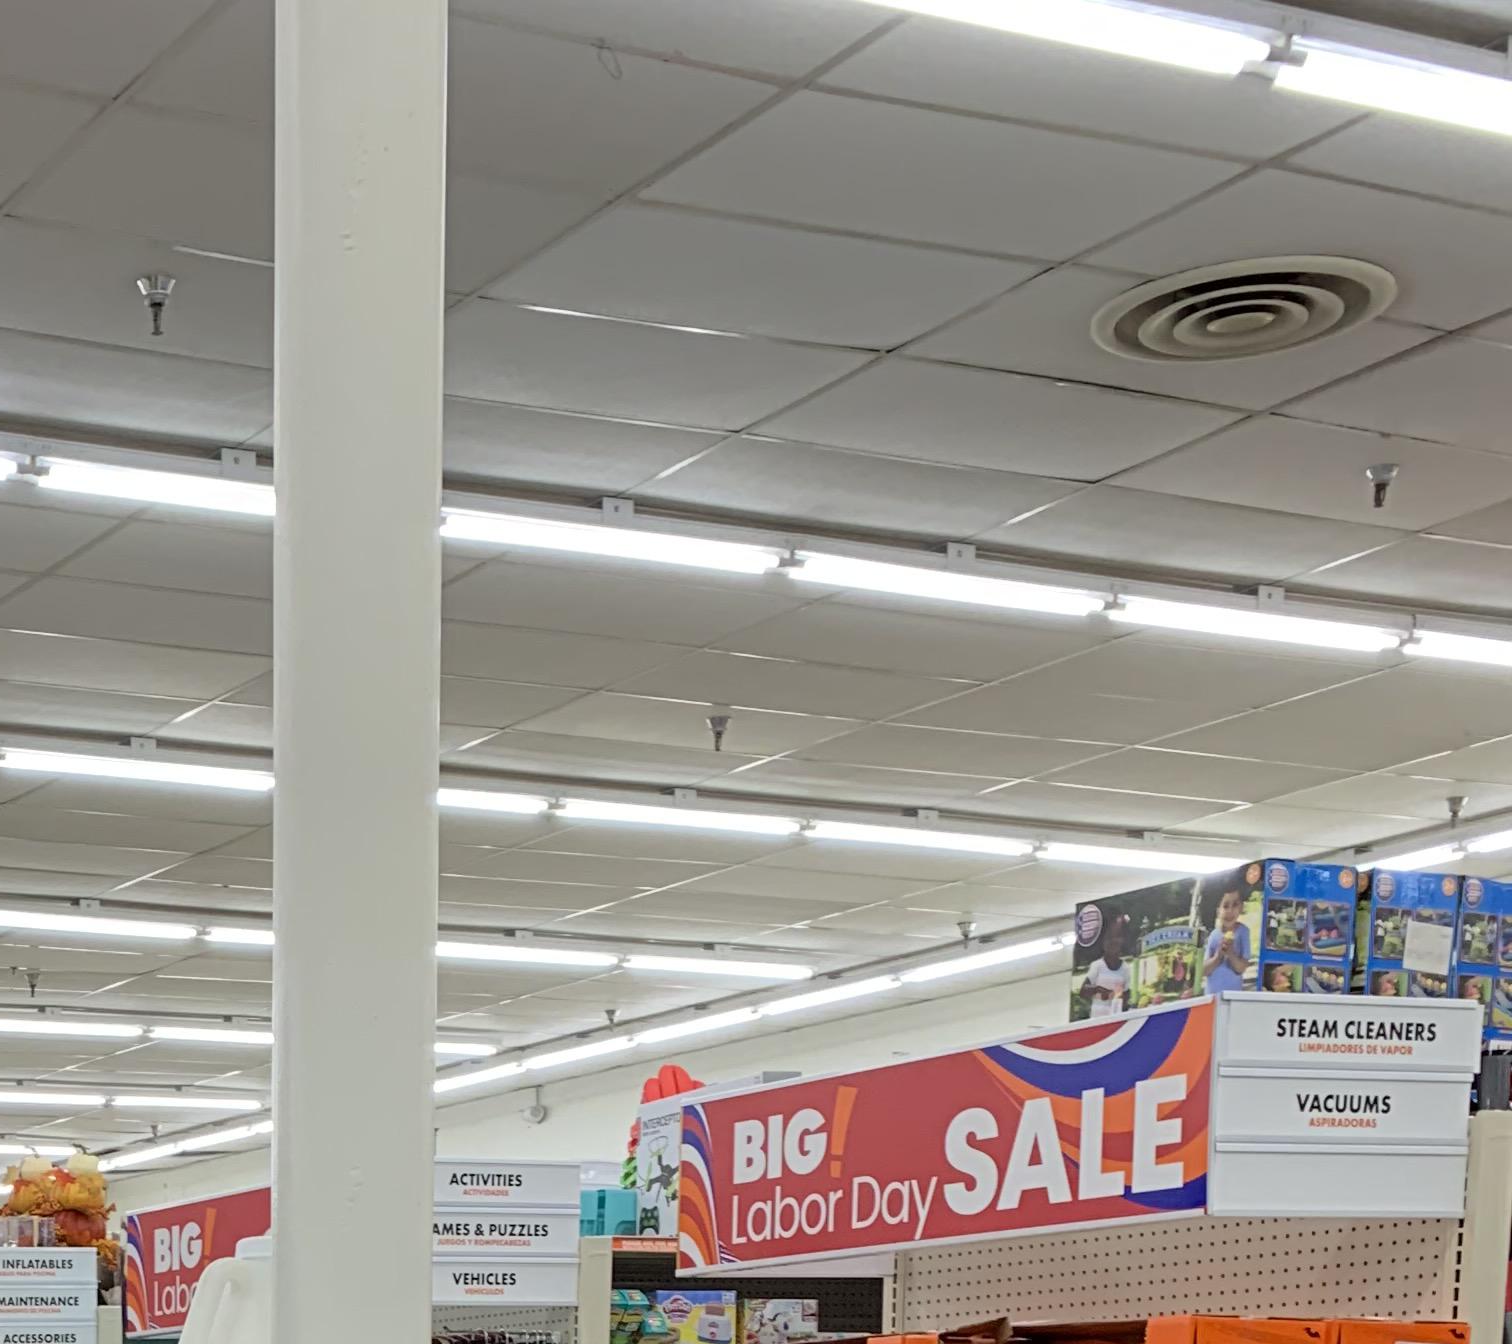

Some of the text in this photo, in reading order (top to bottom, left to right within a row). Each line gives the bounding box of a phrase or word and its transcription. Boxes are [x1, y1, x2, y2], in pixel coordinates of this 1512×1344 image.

[1276, 1018, 1437, 1041] STEAM CLEANERS
[1299, 1043, 1413, 1055] LIMPIADORES DE VAPOR
[1296, 1093, 1391, 1114] VACUUMS
[1309, 1118, 1377, 1128] ASPIRADORAS
[943, 1073, 1187, 1216] SALE
[449, 1173, 522, 1186] ACTIVITIES
[731, 1176, 938, 1245] Labor Day
[433, 1223, 548, 1237] AMES & PUZZLES
[2, 1259, 74, 1269] INFLATABLES
[452, 1273, 516, 1285] VEHICLES
[153, 1278, 199, 1318] Labo
[3, 1333, 77, 1343] ACCESSORIES
